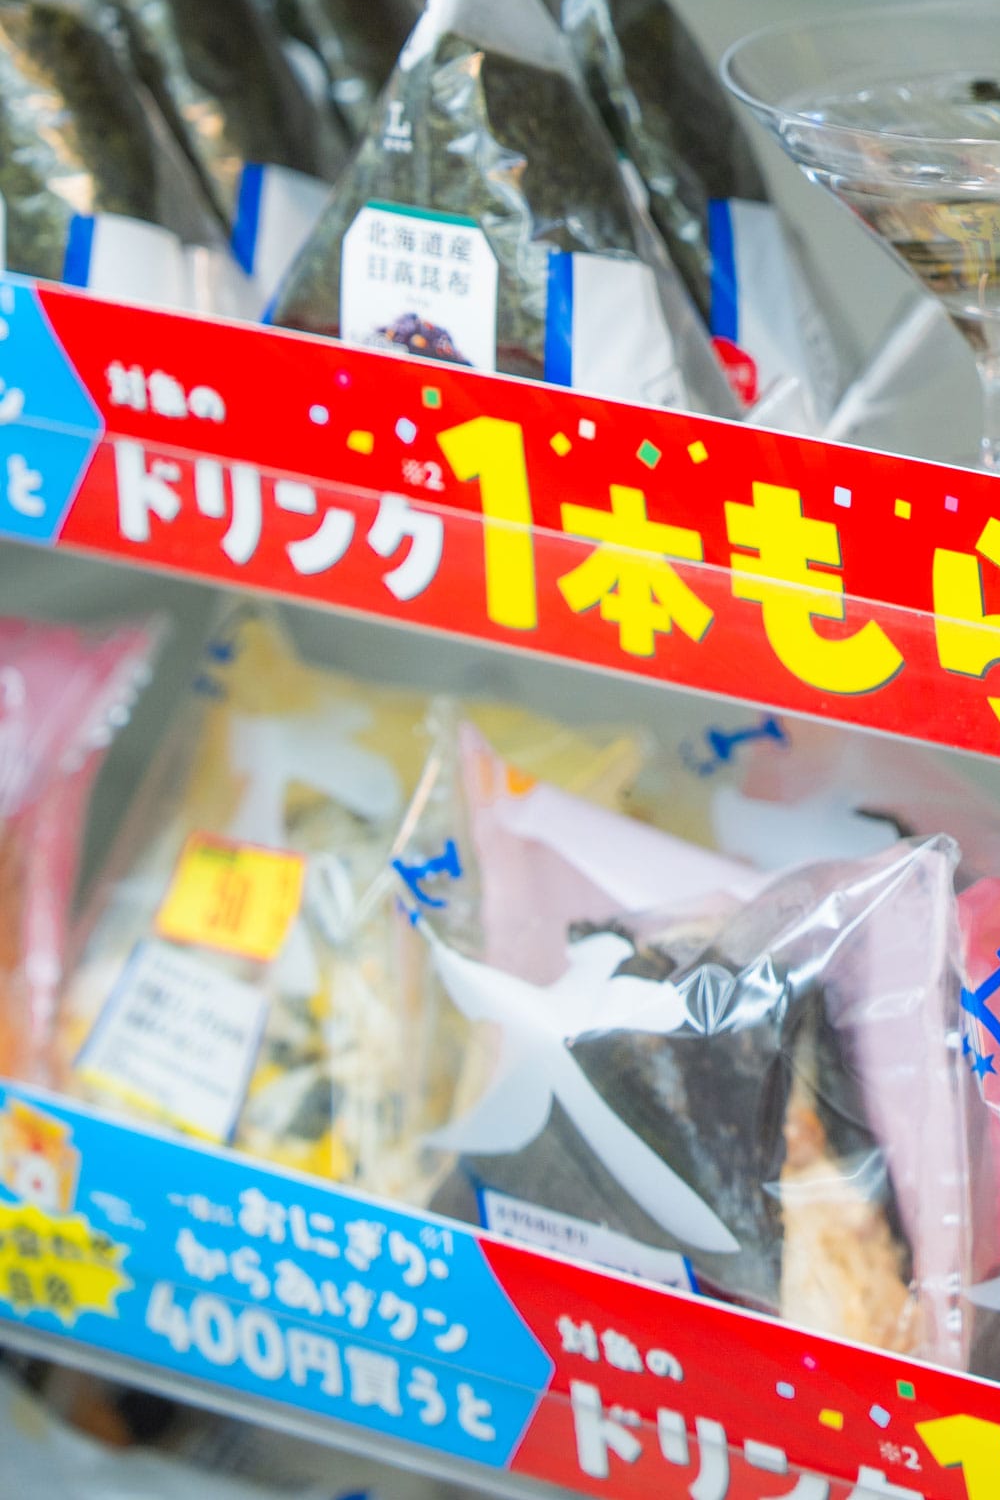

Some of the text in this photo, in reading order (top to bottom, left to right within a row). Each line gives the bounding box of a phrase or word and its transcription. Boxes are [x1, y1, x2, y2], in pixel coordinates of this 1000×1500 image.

[366, 252, 472, 296] 日高昆布
[369, 218, 474, 264] 北海道産
[105, 360, 226, 424] 対象の
[115, 438, 445, 601] ドリンク
[175, 1227, 469, 1354] からあげクン
[145, 1279, 497, 1443] 400円買うと
[555, 1314, 683, 1383] 対象の
